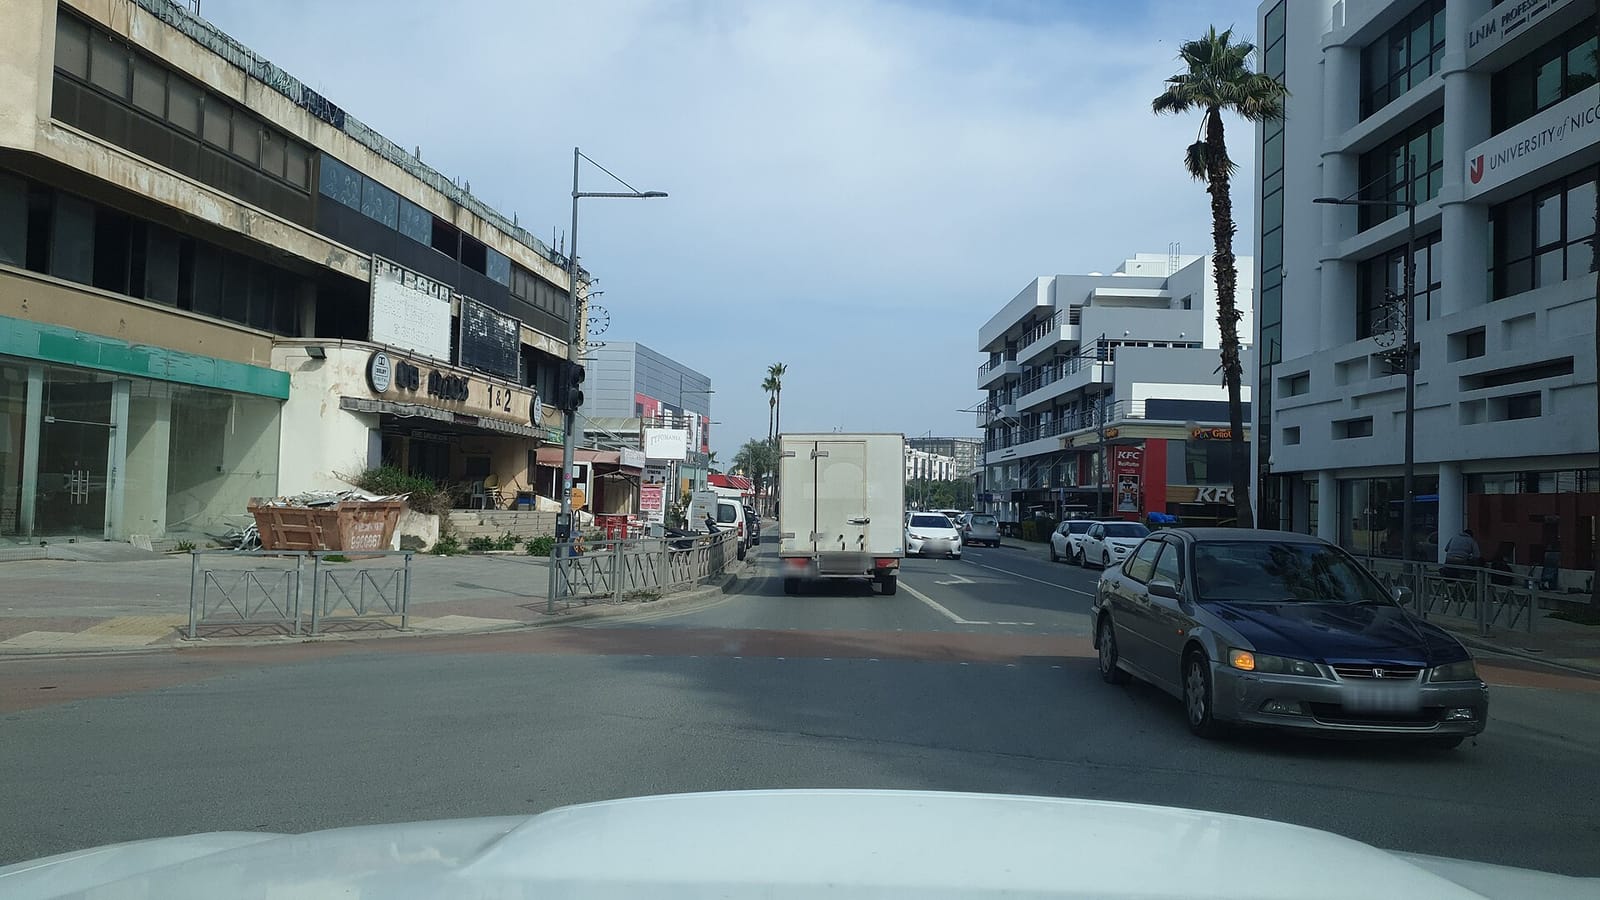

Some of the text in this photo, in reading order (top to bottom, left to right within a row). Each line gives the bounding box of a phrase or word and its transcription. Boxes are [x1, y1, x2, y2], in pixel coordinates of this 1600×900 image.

[1469, 18, 1497, 48] LNM
[1490, 126, 1555, 170] UNIVERSITY
[1556, 115, 1570, 141] of
[487, 384, 493, 409] 1
[495, 391, 501, 406] &
[503, 391, 511, 413] 2
[1117, 451, 1140, 460] KFC
